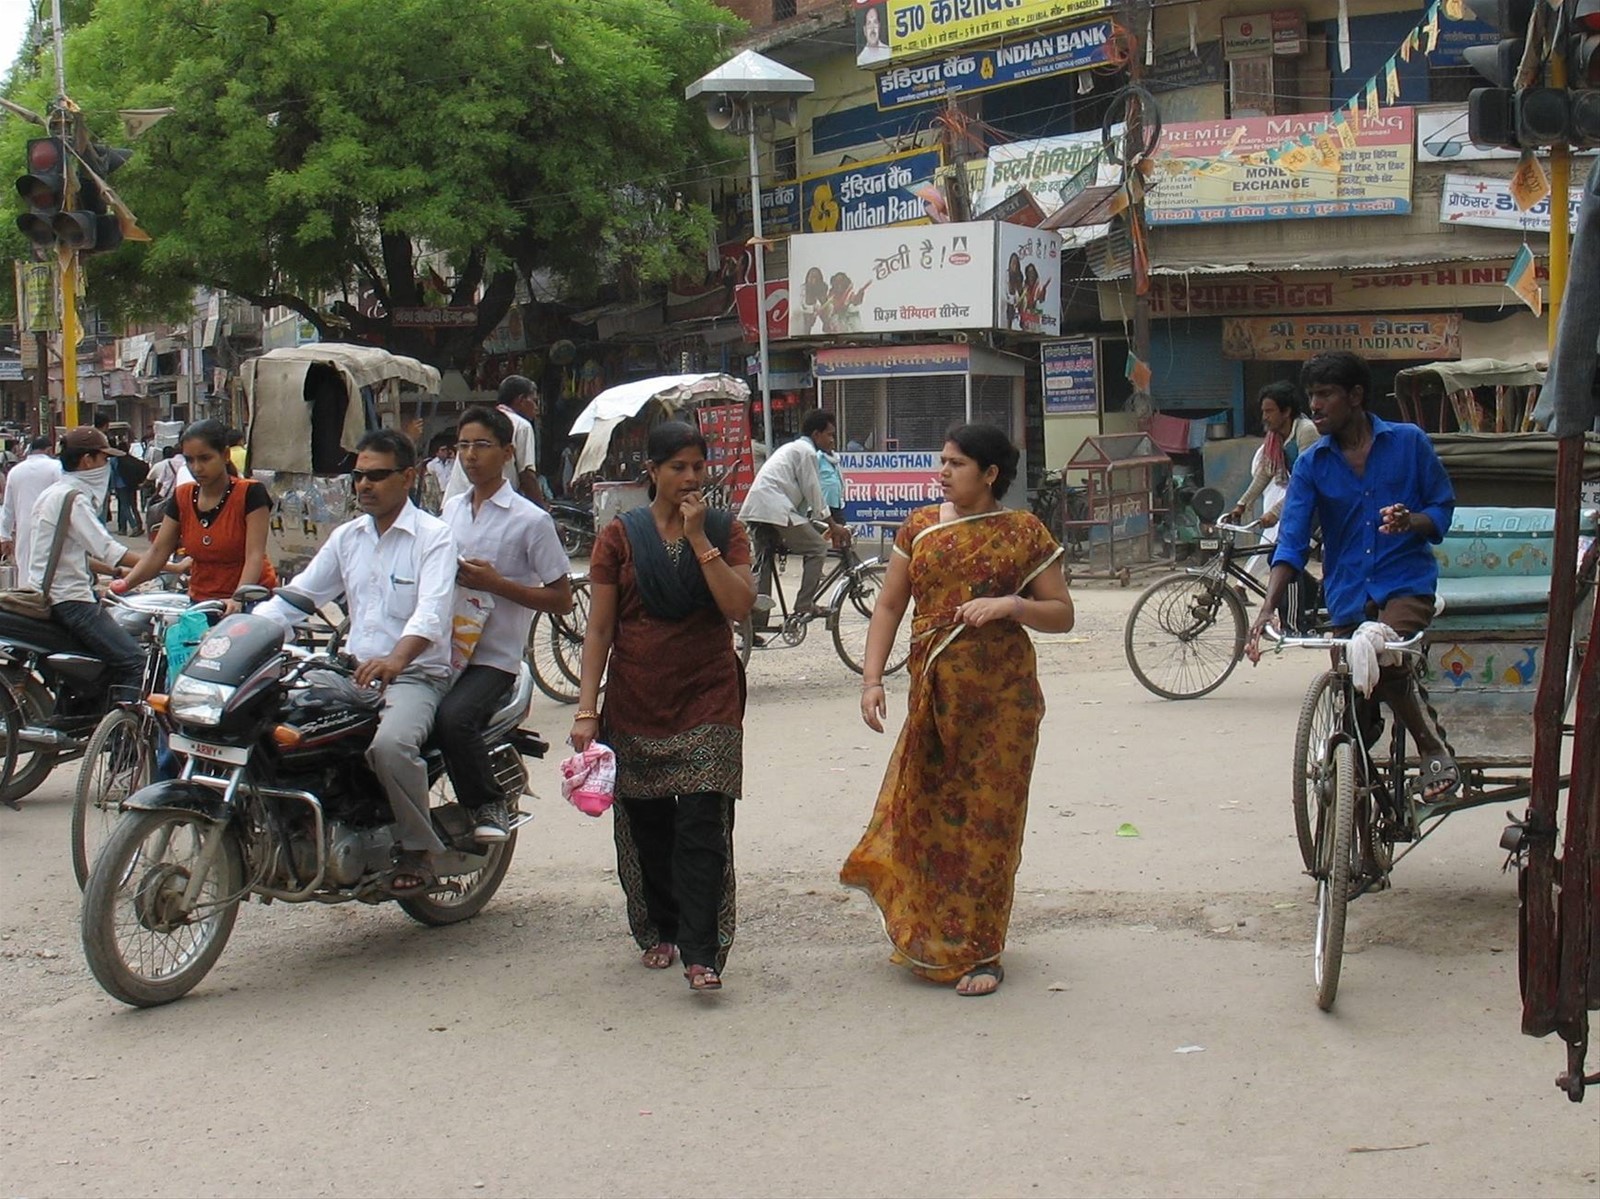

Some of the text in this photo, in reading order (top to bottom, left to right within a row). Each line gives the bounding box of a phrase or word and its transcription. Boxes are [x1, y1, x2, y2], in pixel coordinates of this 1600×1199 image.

[997, 38, 1054, 67] INDIAN
[1056, 25, 1107, 53] BANK
[880, 65, 940, 93] इंडियन
[943, 56, 976, 77] बैंक
[840, 165, 912, 203] इंडियन बैंक
[1232, 178, 1310, 191] EXCHANGE
[1246, 167, 1288, 178] MONE
[842, 192, 926, 231] Indian Bank
[873, 244, 911, 281] होली
[900, 305, 937, 320] चैम्पियन
[1284, 337, 1414, 351] & SOUTH INDIAN
[875, 482, 924, 505] सहायता
